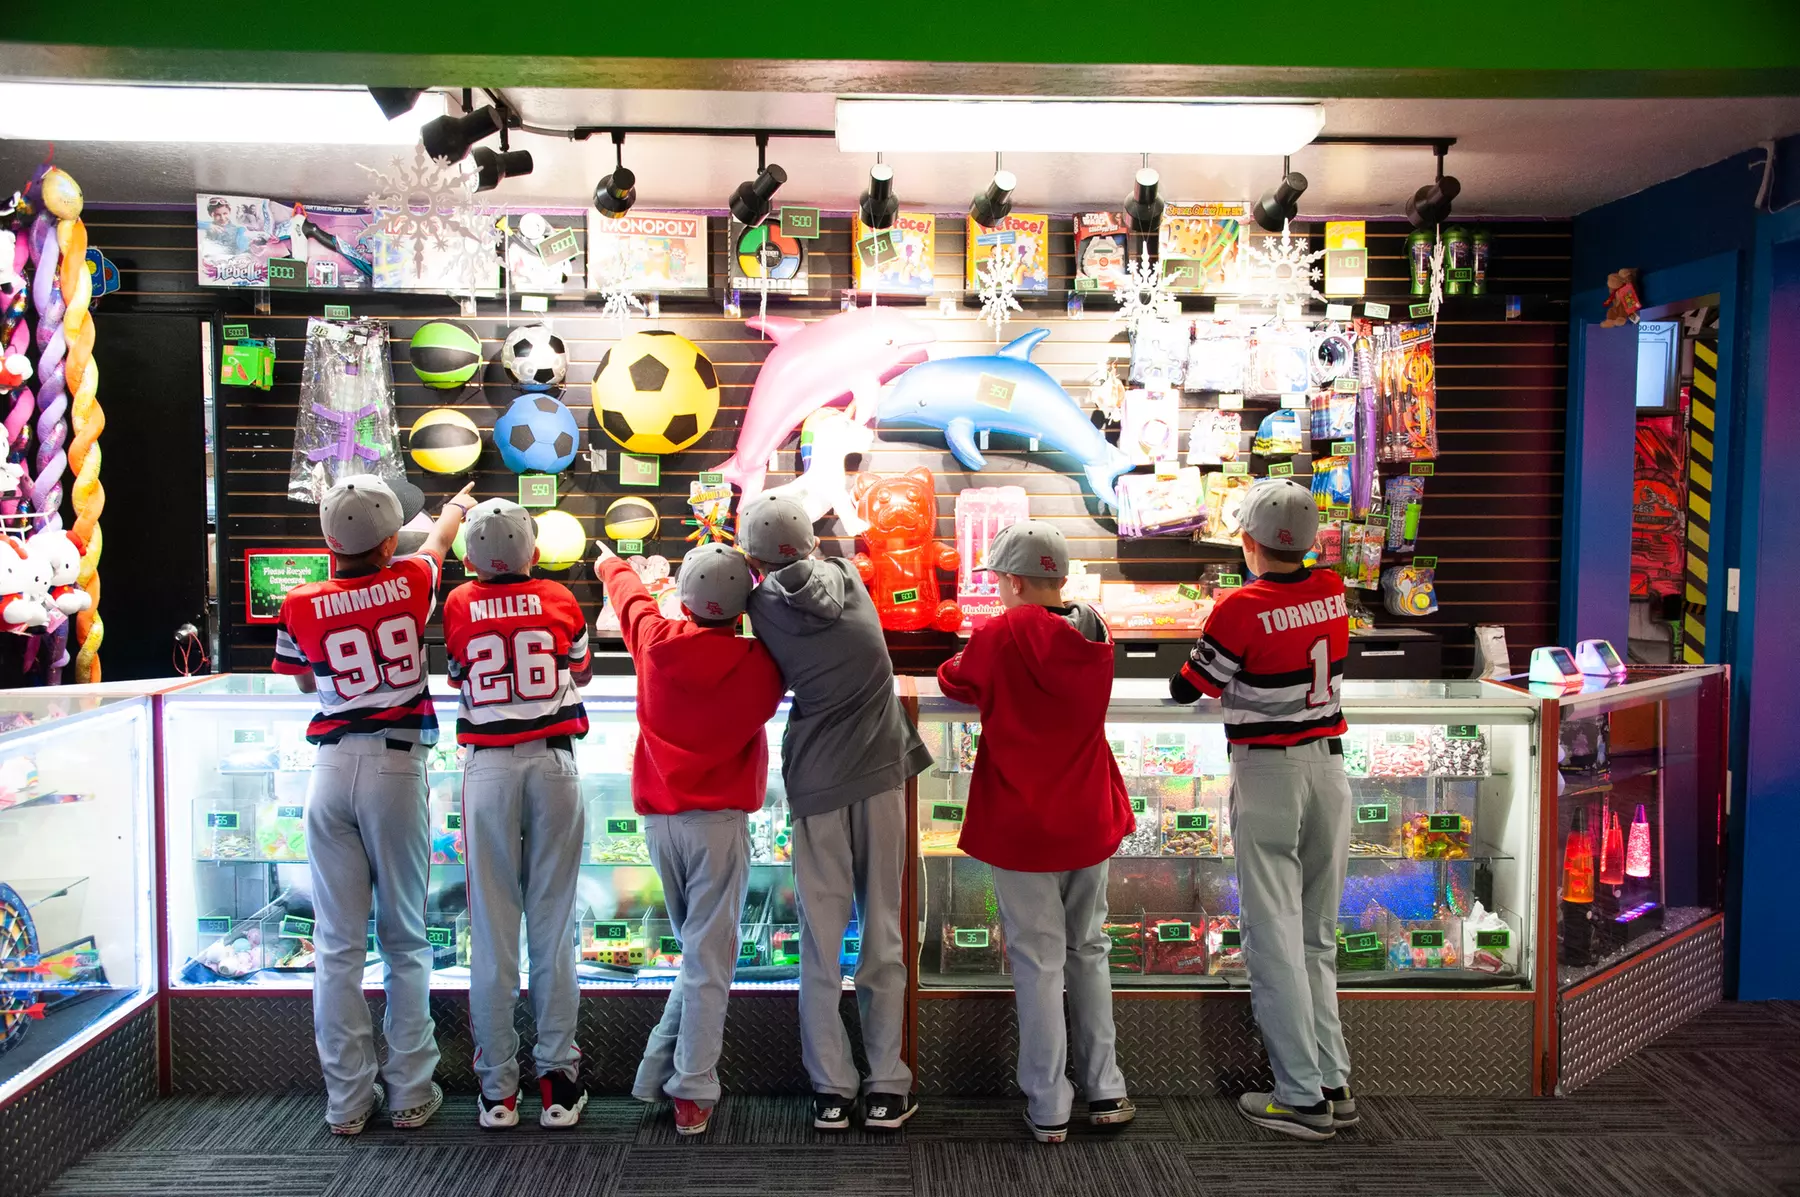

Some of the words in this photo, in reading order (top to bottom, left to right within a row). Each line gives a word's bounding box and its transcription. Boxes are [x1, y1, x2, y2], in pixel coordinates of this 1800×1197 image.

[788, 215, 812, 228] 7500
[1004, 216, 1045, 234] Face!
[602, 219, 695, 238] MONOPOLY
[269, 265, 295, 280] 8000
[1276, 465, 1289, 474] 400
[531, 483, 550, 496] 550
[1333, 508, 1346, 518] 200
[263, 567, 285, 576] Please
[311, 576, 412, 620] TIMMONS
[469, 593, 543, 623] MILLER
[320, 612, 422, 701] 99
[467, 626, 559, 707] 26
[1306, 634, 1334, 709] 1
[285, 807, 296, 817] 50
[1368, 808, 1378, 819] 30
[616, 821, 628, 832] 40
[1191, 816, 1203, 827] 20
[1440, 817, 1451, 828] 30
[429, 932, 444, 942] 200
[1169, 926, 1181, 937] 50
[967, 933, 977, 943] 35
